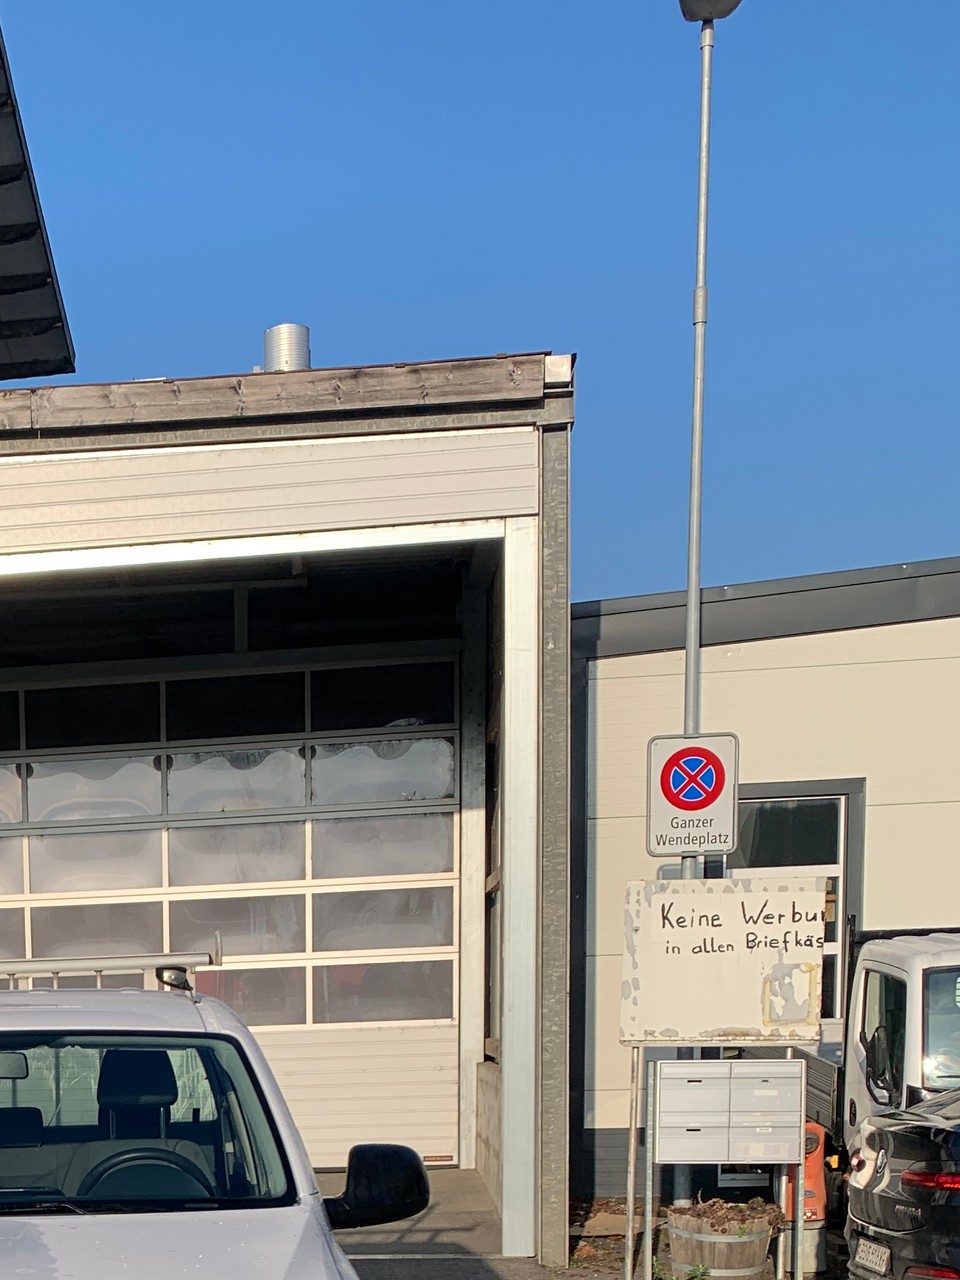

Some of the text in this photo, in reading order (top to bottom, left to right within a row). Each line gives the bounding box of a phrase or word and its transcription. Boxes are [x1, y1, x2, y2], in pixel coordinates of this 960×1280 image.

[670, 816, 714, 829] Ganzer
[655, 832, 729, 847] Wendeplatz
[661, 901, 723, 929] Keine
[666, 940, 681, 955] in
[691, 937, 735, 955] allen
